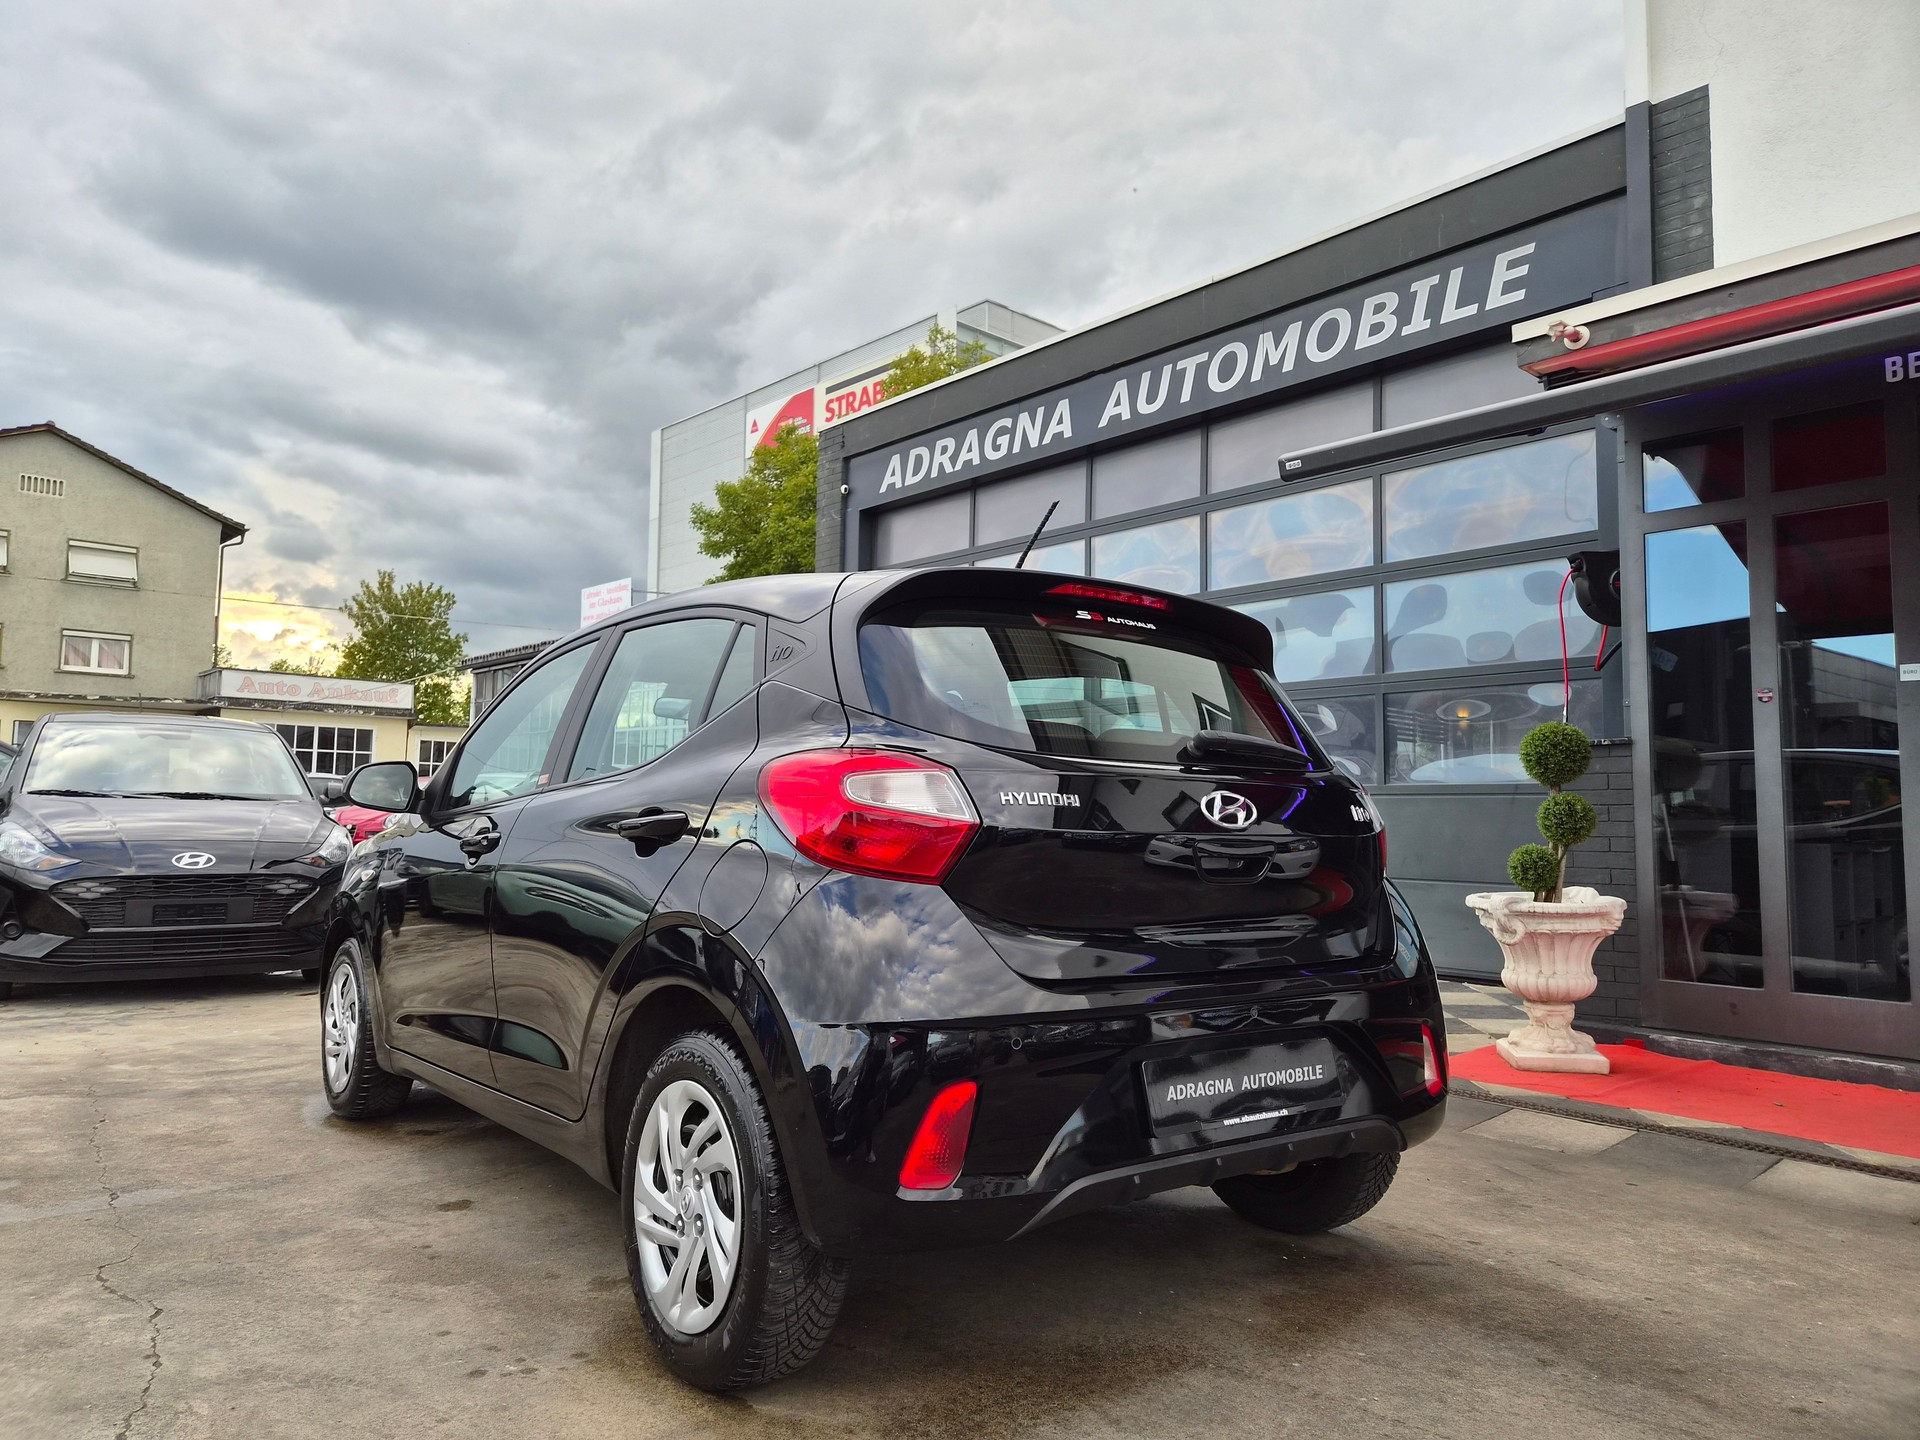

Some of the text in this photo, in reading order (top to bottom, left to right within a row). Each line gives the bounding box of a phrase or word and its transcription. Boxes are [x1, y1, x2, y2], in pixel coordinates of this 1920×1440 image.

[879, 242, 1536, 494] ADRAGNA AUTOMOBILE
[825, 379, 898, 422] STRAB
[1107, 616, 1156, 630] AUTOHAUS
[236, 676, 399, 703] Auto Ankauf
[1000, 791, 1080, 807] HYUNDAI
[1167, 1064, 1323, 1102] ADRAGNA AUTOMOBILE
[1223, 1108, 1288, 1126] www.sbautohaus.ch
